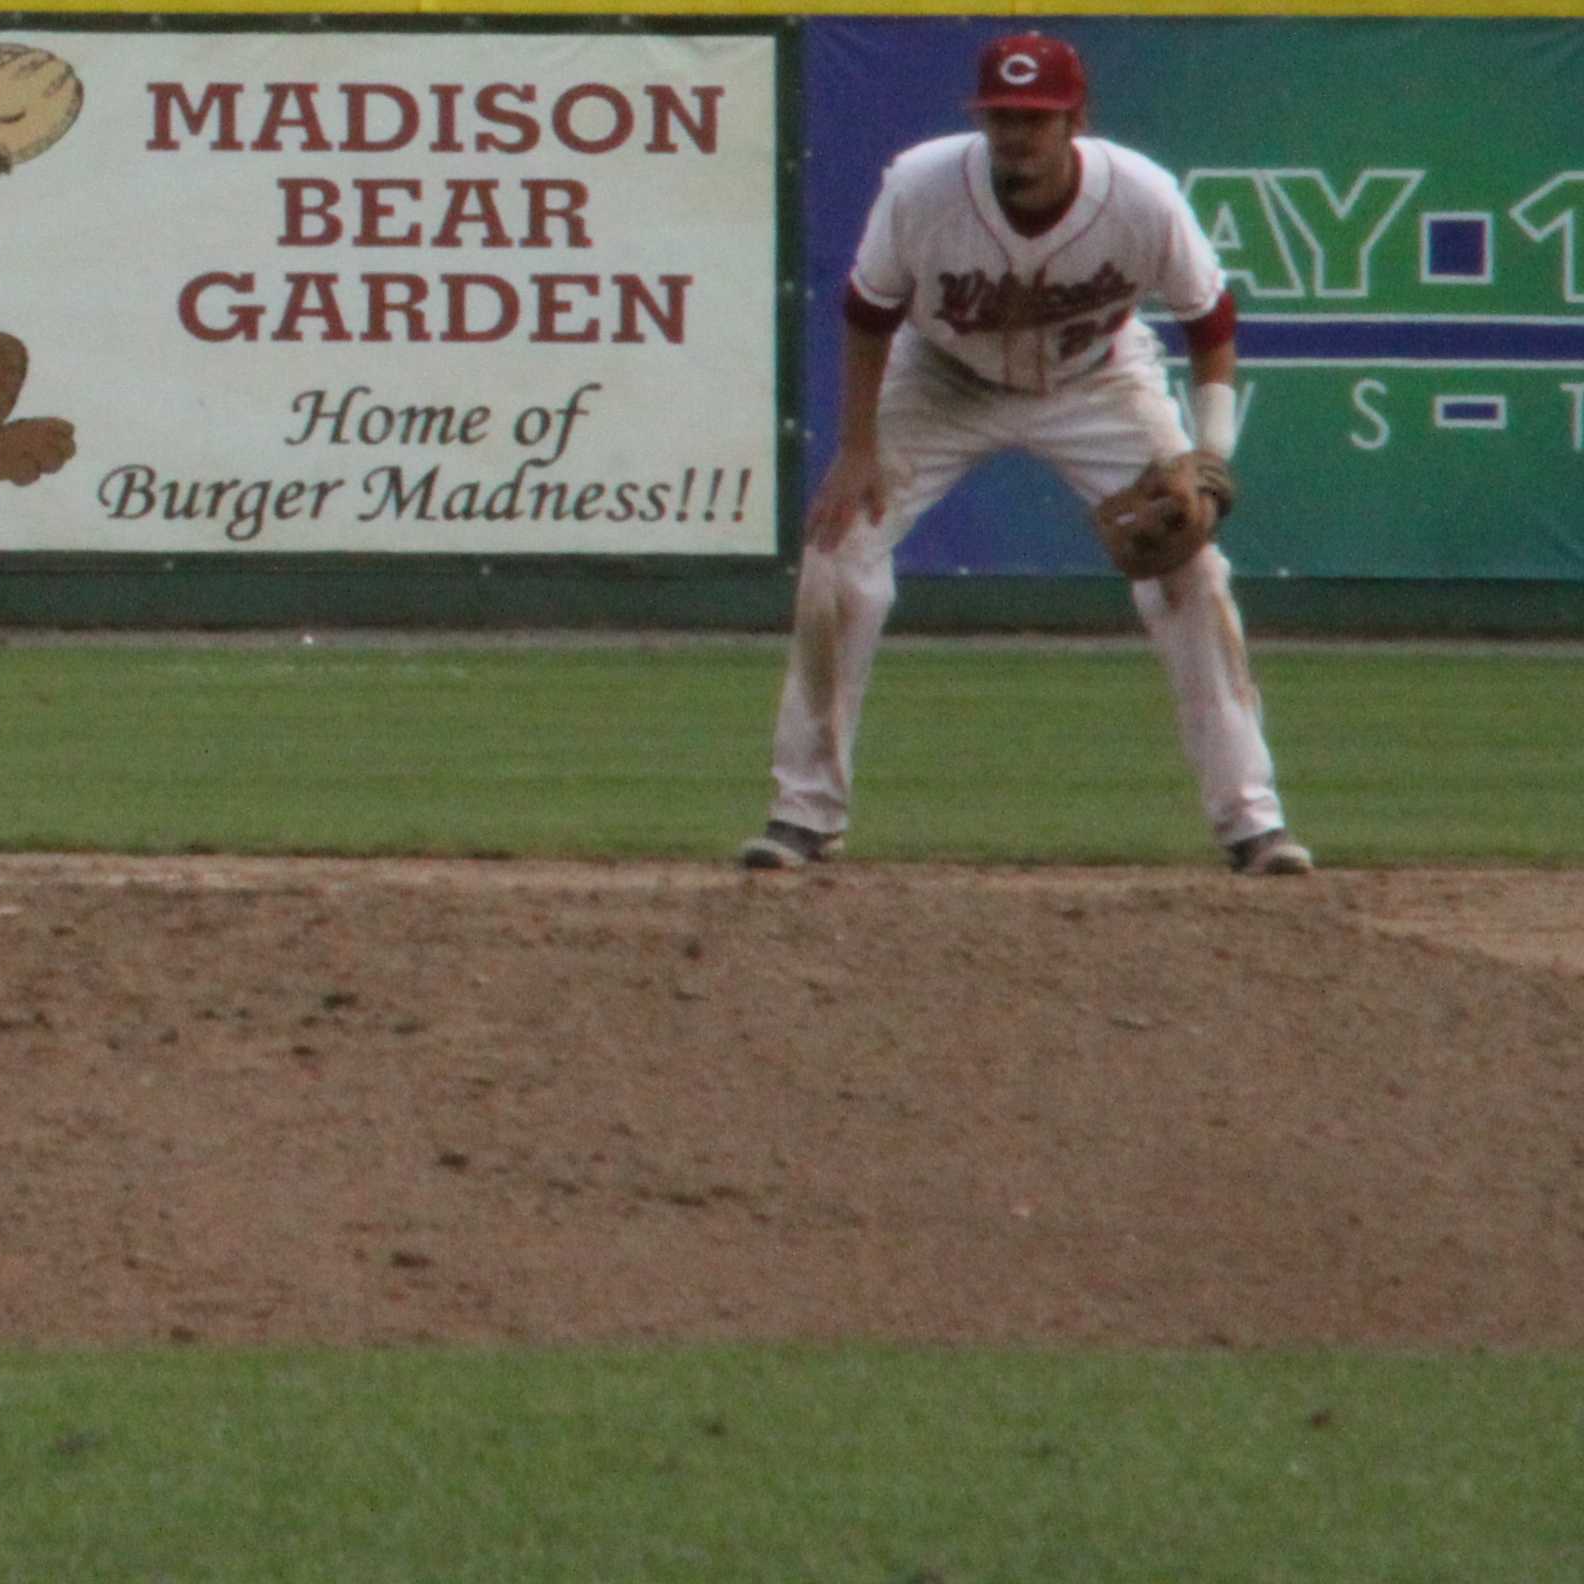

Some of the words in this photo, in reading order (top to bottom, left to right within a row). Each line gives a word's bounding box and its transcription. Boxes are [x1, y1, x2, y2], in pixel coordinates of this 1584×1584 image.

[999, 53, 1039, 85] C
[144, 81, 726, 155] MADISON
[275, 177, 595, 249] BEAR
[176, 271, 694, 345] GARDEN
[283, 385, 492, 448] Home
[512, 383, 604, 466] of
[96, 463, 345, 543] Burger
[355, 459, 754, 525] Madness!!!
